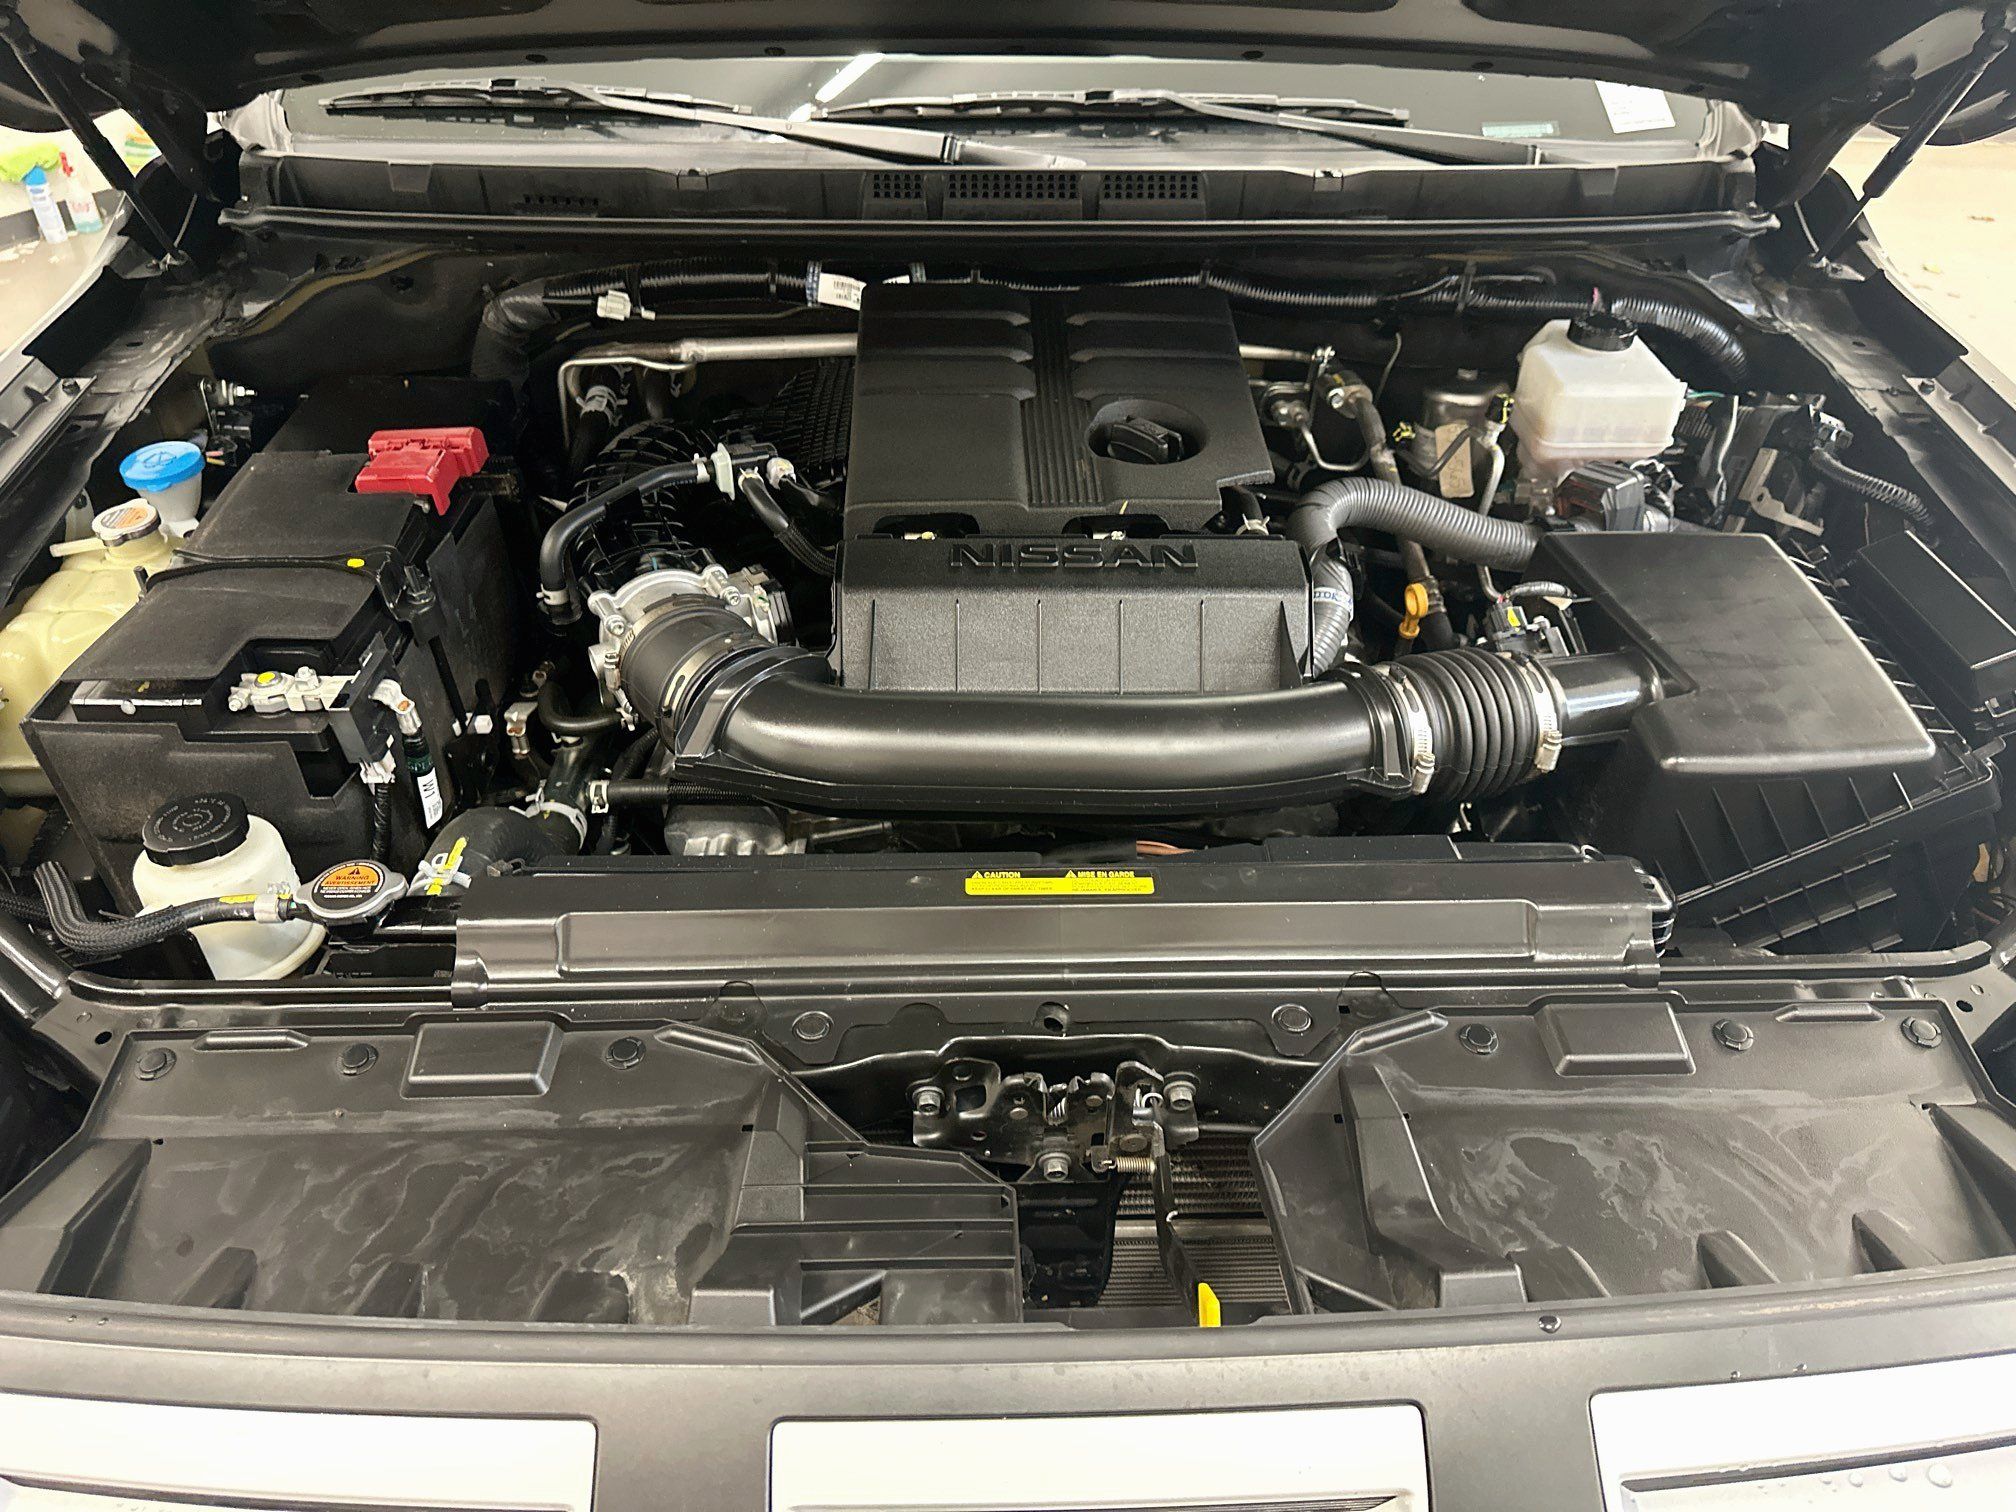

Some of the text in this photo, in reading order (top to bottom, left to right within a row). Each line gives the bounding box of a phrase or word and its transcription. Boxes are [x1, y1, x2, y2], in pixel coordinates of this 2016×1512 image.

[950, 543, 1199, 568] NISSAN
[983, 871, 1021, 879] CAUTION
[1077, 870, 1135, 878] MISE EN GARDE
